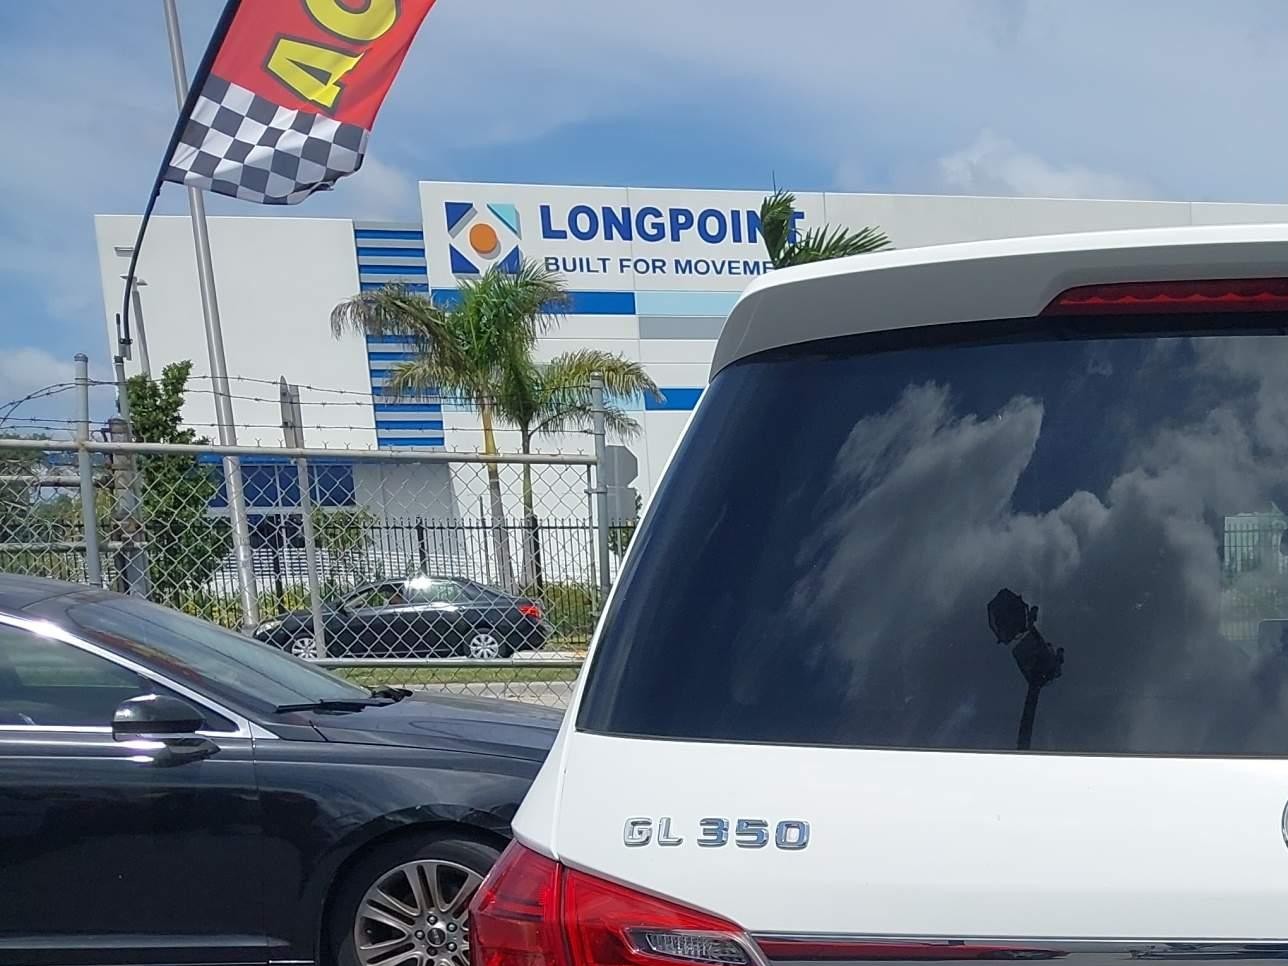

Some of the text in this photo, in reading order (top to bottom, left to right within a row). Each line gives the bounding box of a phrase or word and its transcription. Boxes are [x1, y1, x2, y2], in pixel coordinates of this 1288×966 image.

[544, 256, 611, 274] BUILT
[619, 257, 666, 275] FOR
[623, 816, 810, 851] GL 350
